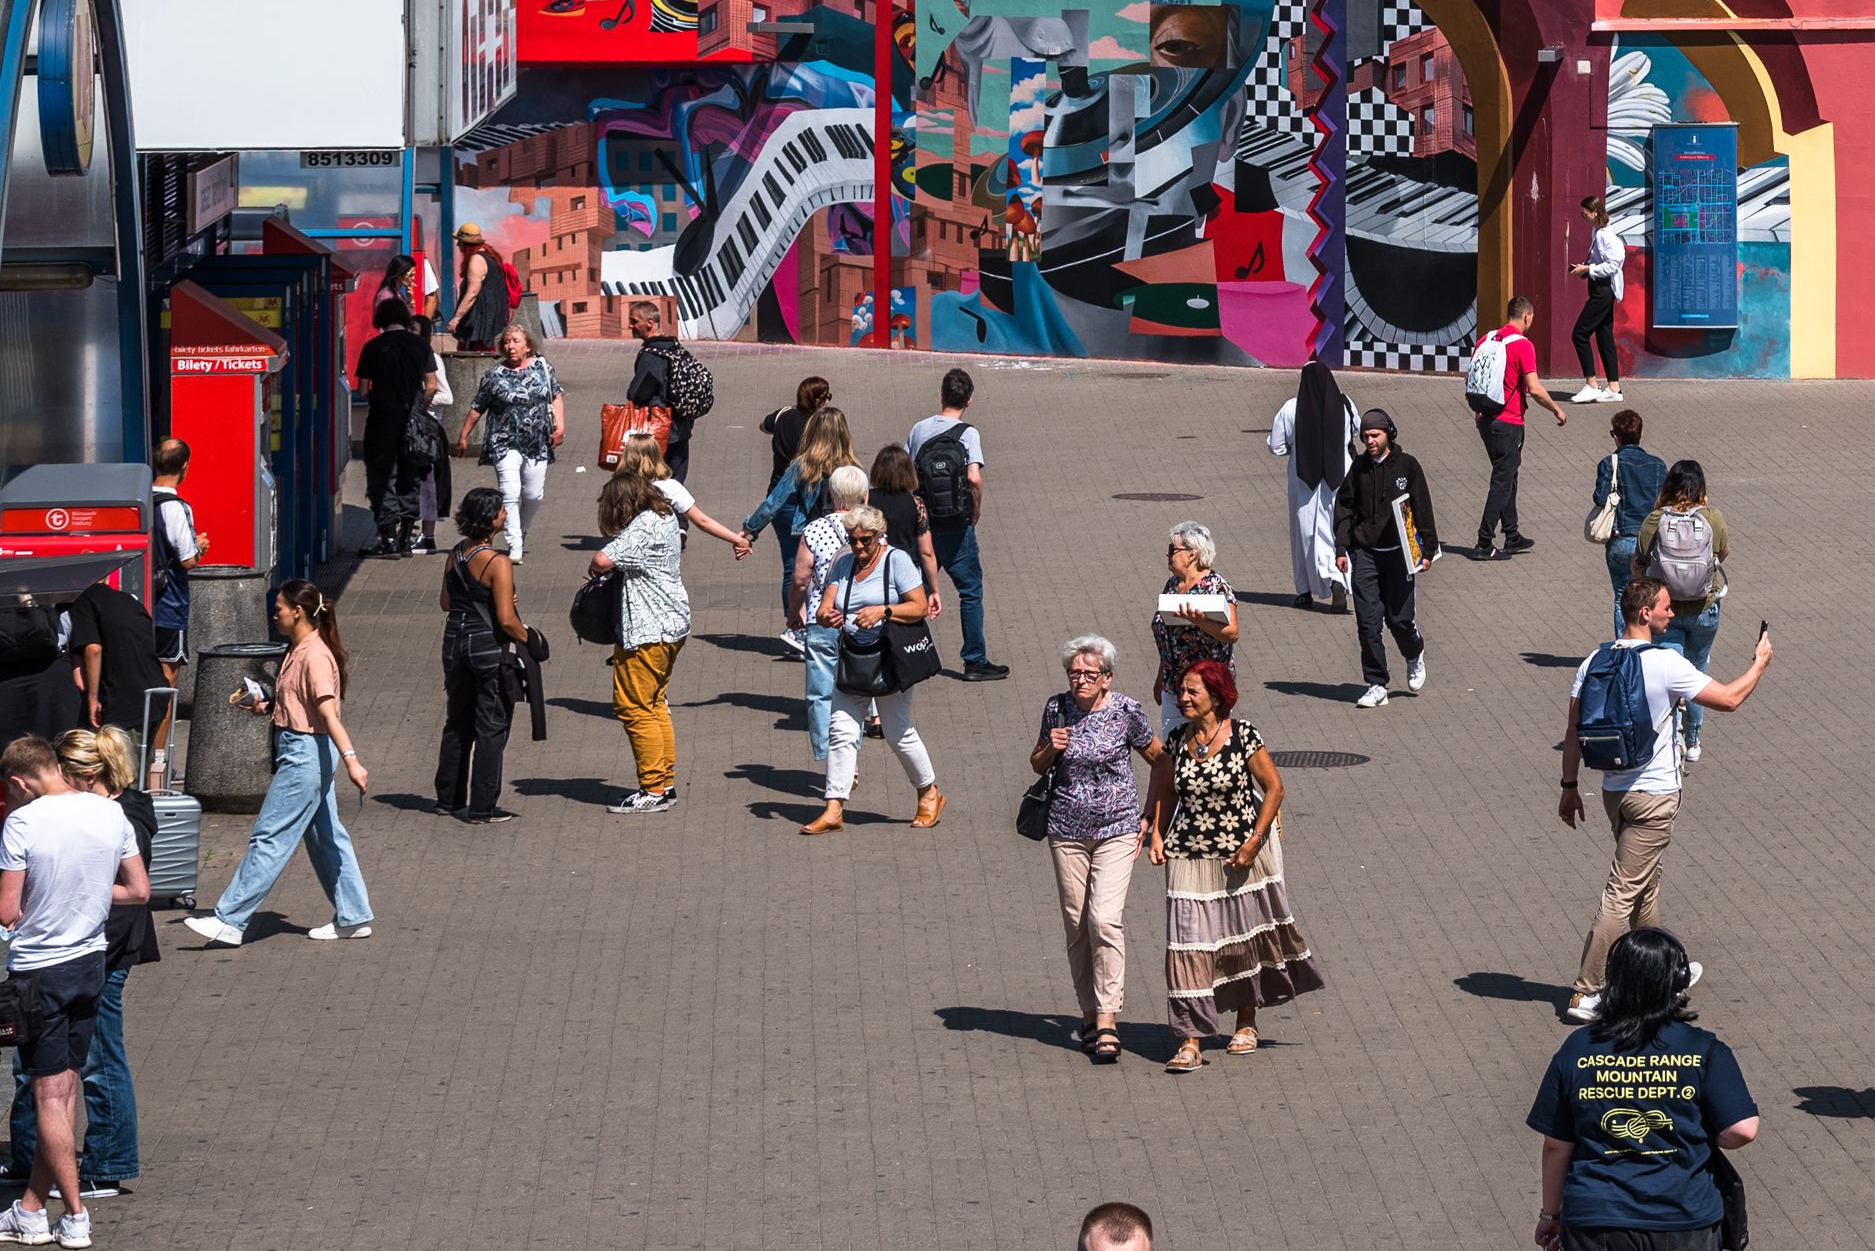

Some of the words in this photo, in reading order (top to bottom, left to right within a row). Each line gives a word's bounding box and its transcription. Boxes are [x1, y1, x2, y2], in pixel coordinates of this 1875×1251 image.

[307, 152, 393, 167] 8513309
[174, 345, 196, 354] bilety
[197, 345, 223, 353] tickets
[224, 345, 265, 353] fahrkarten
[177, 359, 212, 372] Bilety
[215, 360, 220, 370] /
[221, 359, 262, 370] Tickets
[1577, 1054, 1646, 1069] CASCADE
[1649, 1054, 1702, 1068] RANGE
[1596, 1070, 1677, 1083] MOUNTAIN
[1579, 1087, 1634, 1100] RESCUE
